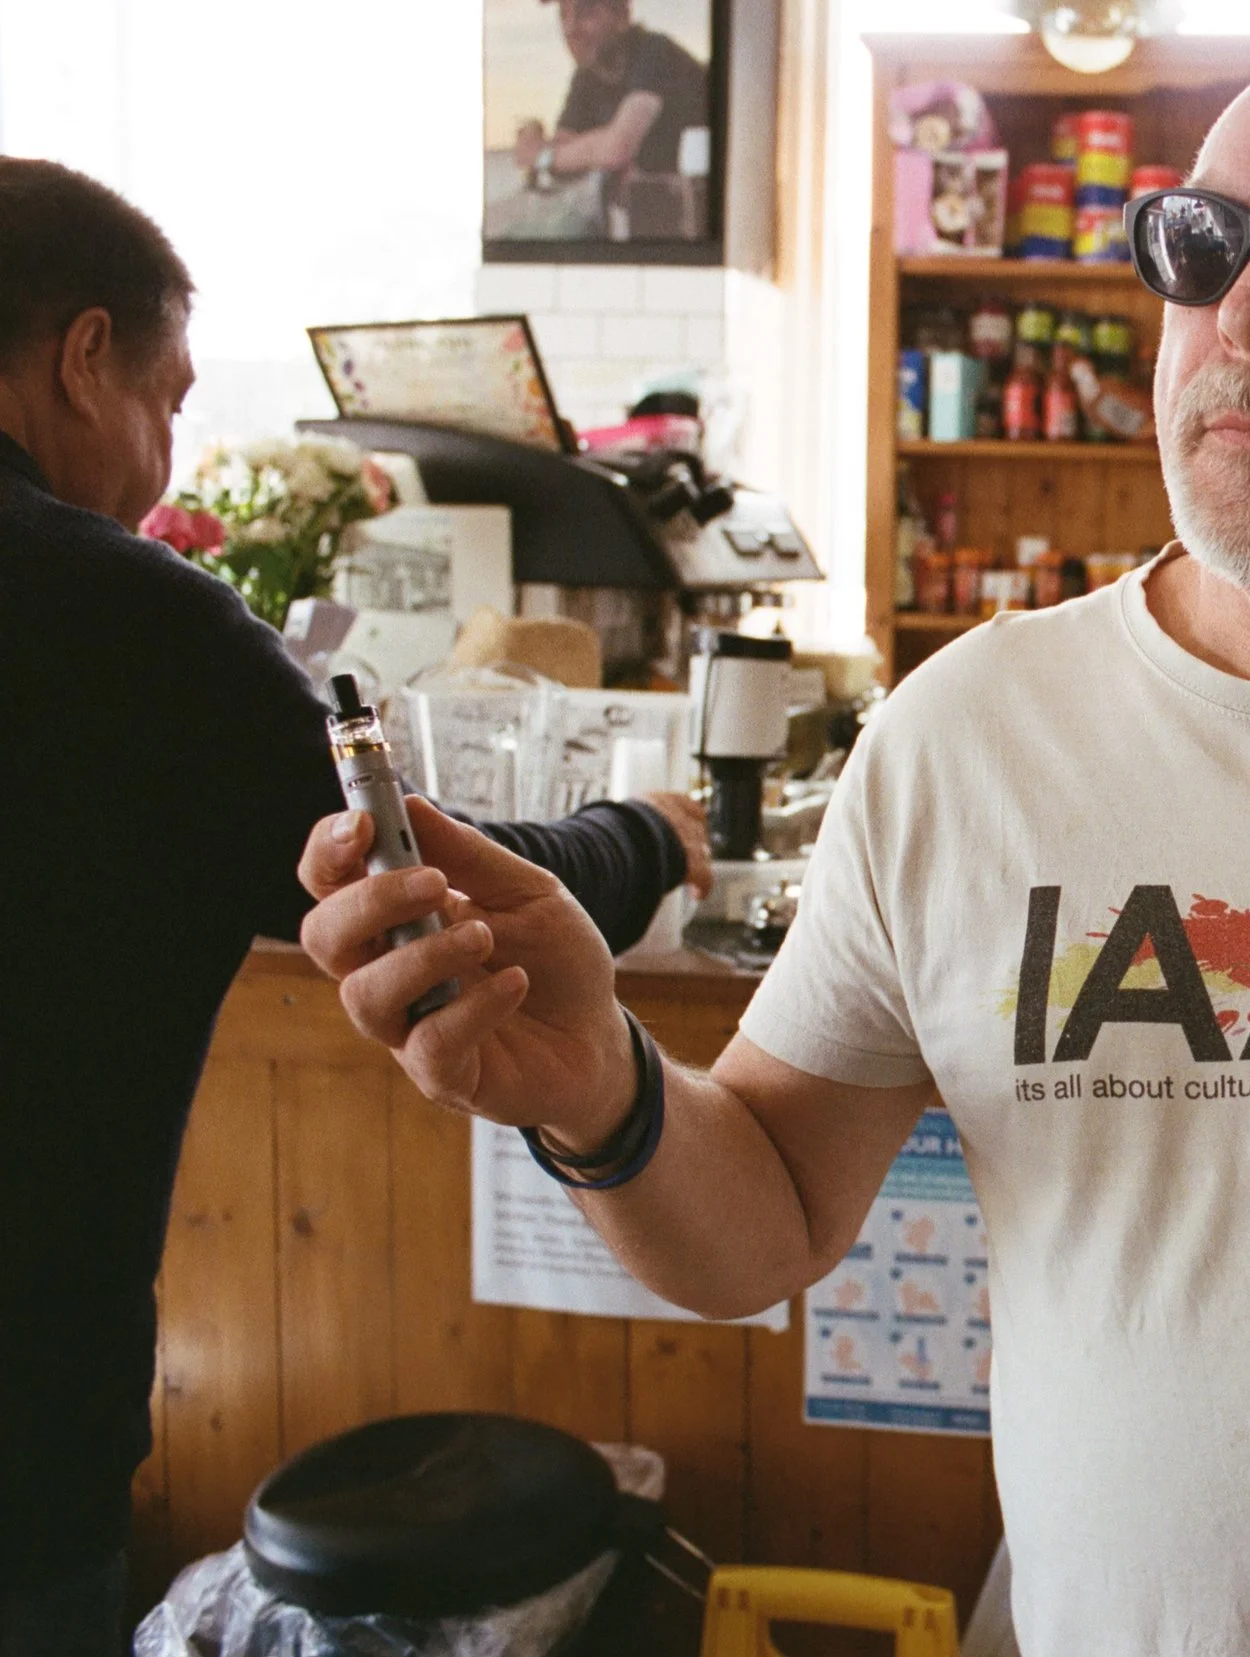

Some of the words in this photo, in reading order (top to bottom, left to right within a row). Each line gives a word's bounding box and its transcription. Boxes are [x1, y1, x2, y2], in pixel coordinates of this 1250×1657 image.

[1015, 1079, 1045, 1101] its
[1054, 1075, 1081, 1099] all
[1092, 1075, 1174, 1099] about
